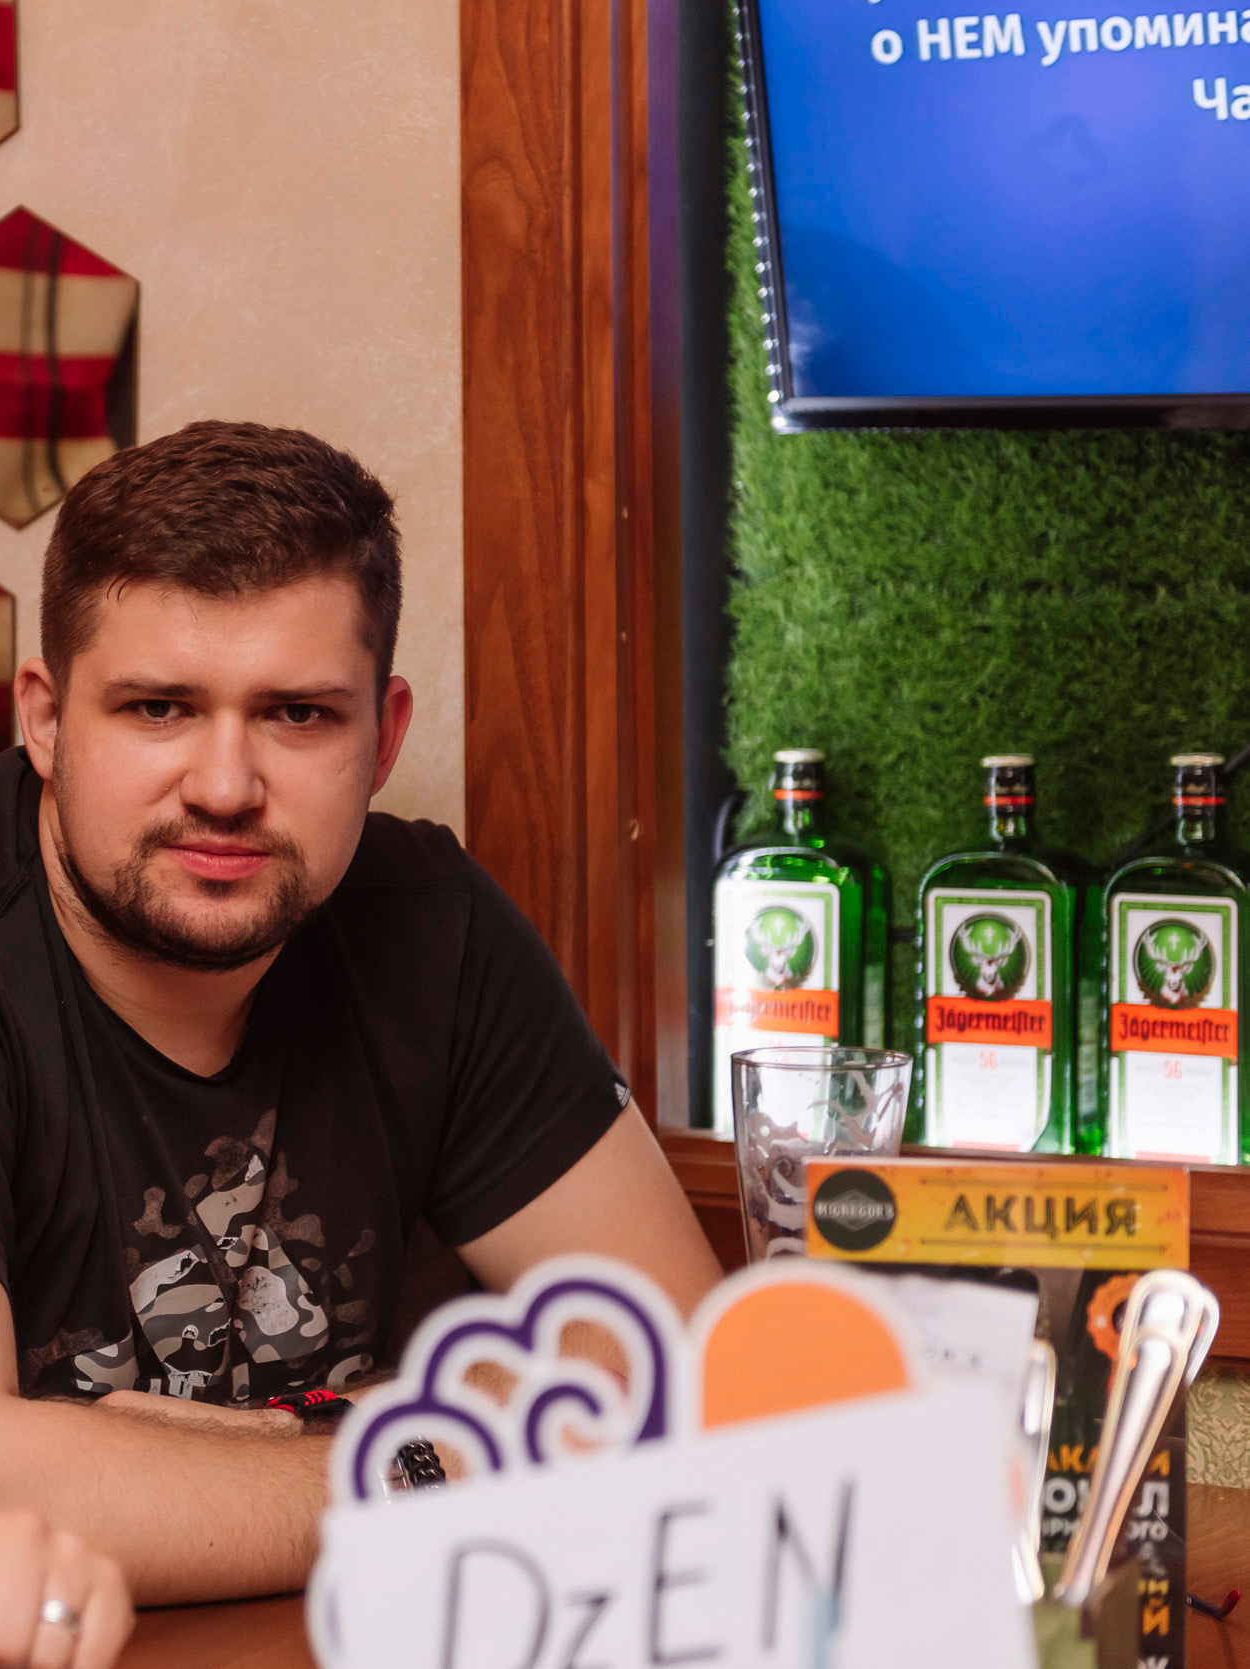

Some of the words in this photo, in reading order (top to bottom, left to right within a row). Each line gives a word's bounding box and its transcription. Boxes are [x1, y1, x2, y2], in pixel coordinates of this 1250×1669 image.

[871, 29, 902, 65] о
[917, 13, 1025, 62] НЕМ
[979, 1049, 999, 1071] 56
[1163, 1059, 1183, 1080] 56
[944, 1193, 1137, 1241] АКЦИЯ
